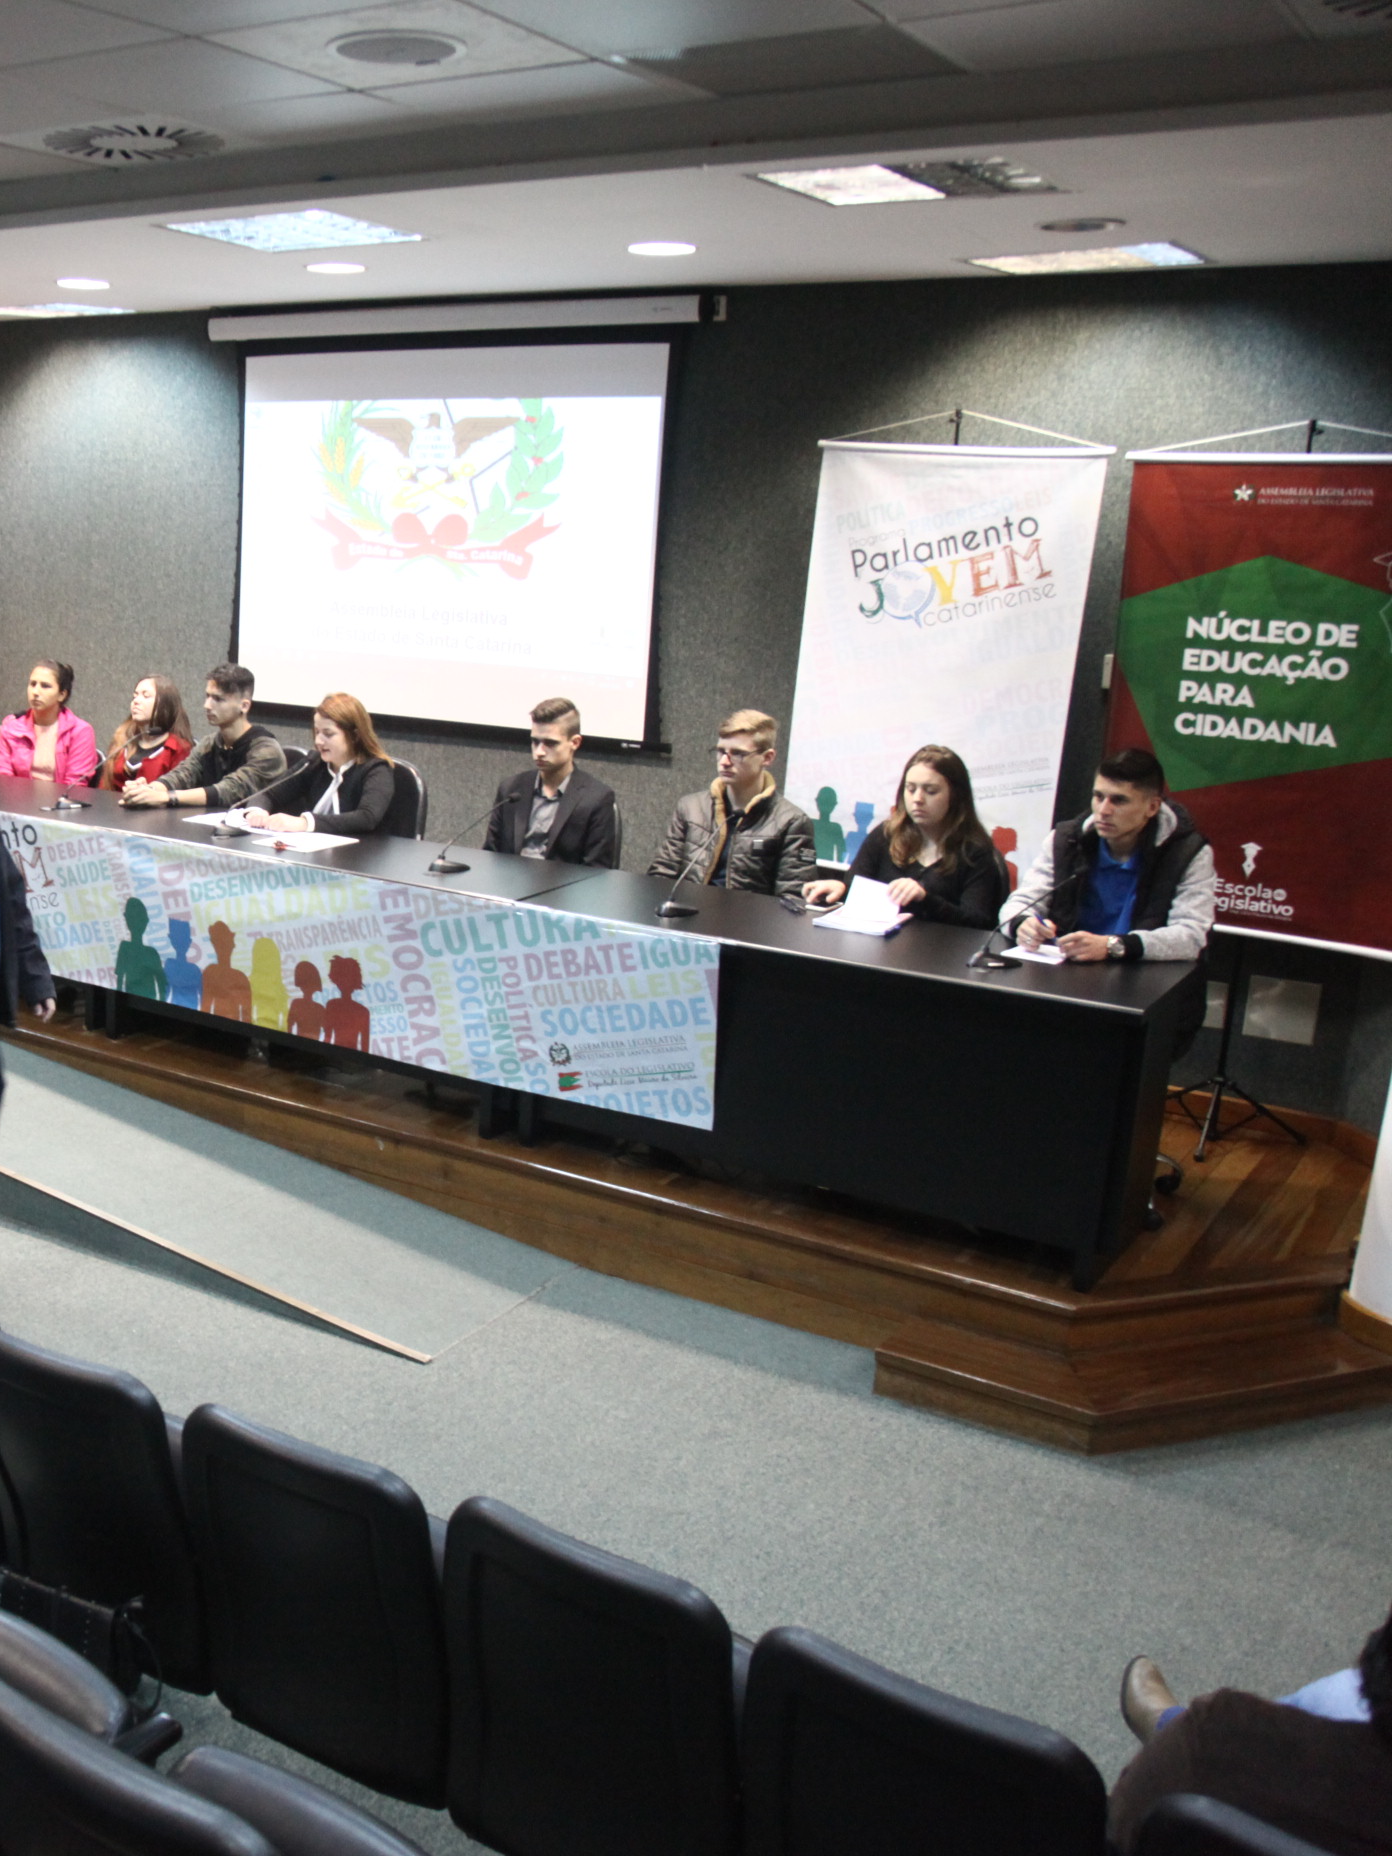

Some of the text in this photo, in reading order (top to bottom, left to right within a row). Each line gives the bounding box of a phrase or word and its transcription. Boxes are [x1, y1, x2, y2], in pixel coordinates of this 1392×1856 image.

[851, 516, 1039, 578] Parlamento
[858, 539, 1053, 628] JOVEM
[330, 601, 508, 626] Assembleia Legislativa
[923, 583, 1057, 627] catarinense
[415, 632, 458, 648] Santa
[464, 635, 532, 656] Catarina
[1185, 610, 1360, 649] NÚCLEO DE
[1182, 648, 1349, 685] EDUCAÇÃO
[1178, 680, 1254, 708] PARA
[1174, 712, 1337, 748] CIDADANIA
[47, 834, 106, 863] DEBATE
[56, 858, 111, 888] SAÚDE
[1213, 878, 1272, 899] Escola
[63, 885, 119, 922] LEIS
[192, 878, 372, 935] IGUALDADE
[1214, 895, 1294, 916] gislativo
[420, 910, 601, 958] CULTURA
[523, 942, 638, 982] DEBATE
[531, 970, 702, 1008] CULTURA LEIS
[498, 956, 537, 1063] POLÍTICA
[540, 997, 711, 1038] SOCIEDADE
[573, 1035, 687, 1051] ASSEMBLEIA LEGISLATIVA
[585, 1061, 695, 1078] ESCOLA DO LEGISLATIVO
